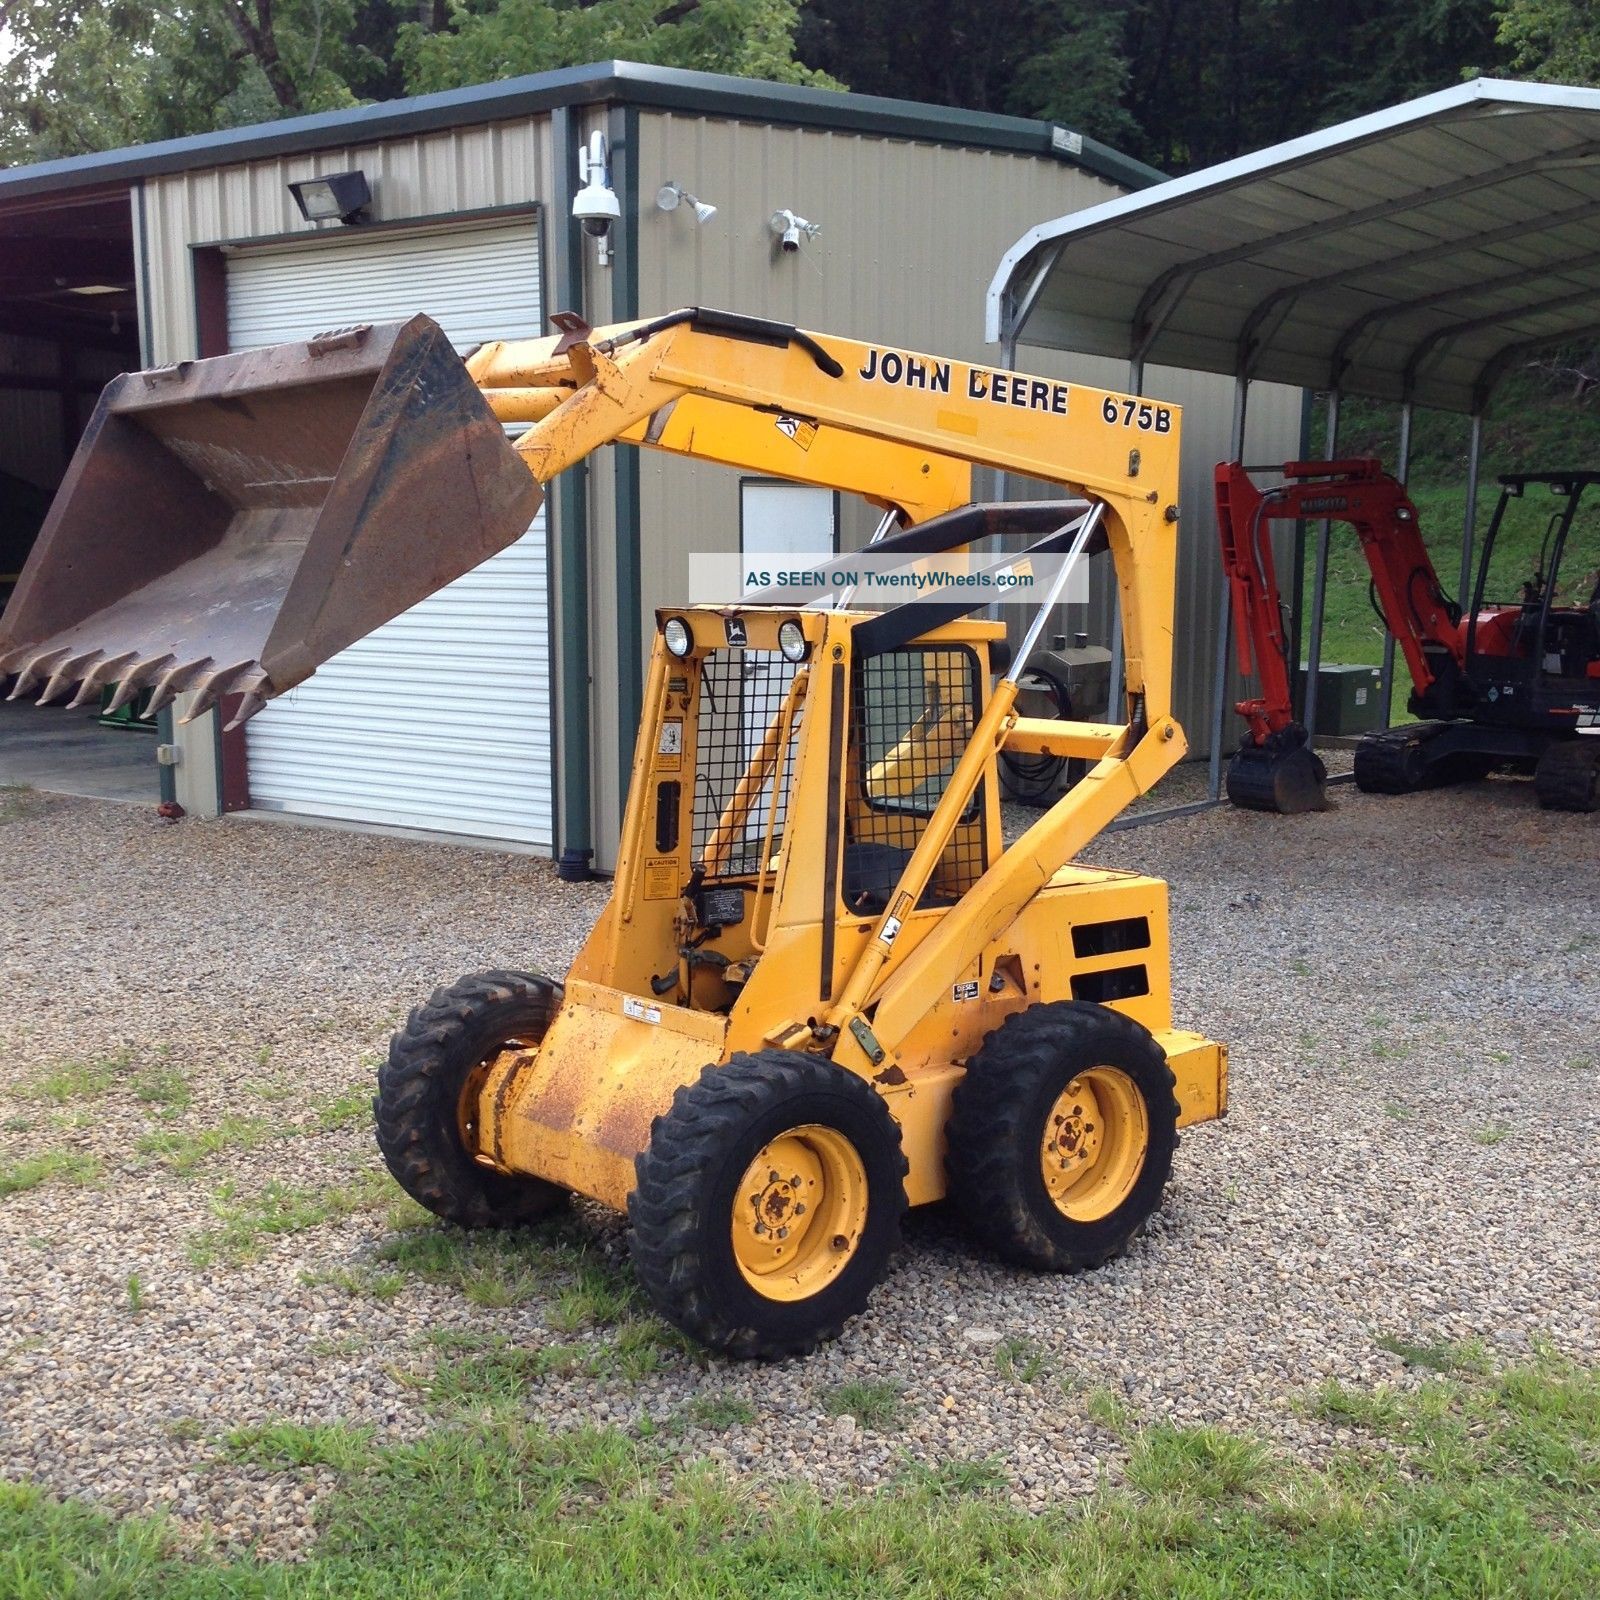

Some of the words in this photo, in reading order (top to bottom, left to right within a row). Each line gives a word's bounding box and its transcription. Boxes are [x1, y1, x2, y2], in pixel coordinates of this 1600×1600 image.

[859, 350, 950, 393] JOHN
[968, 368, 1068, 414] DEERE
[1102, 396, 1171, 433] 675B
